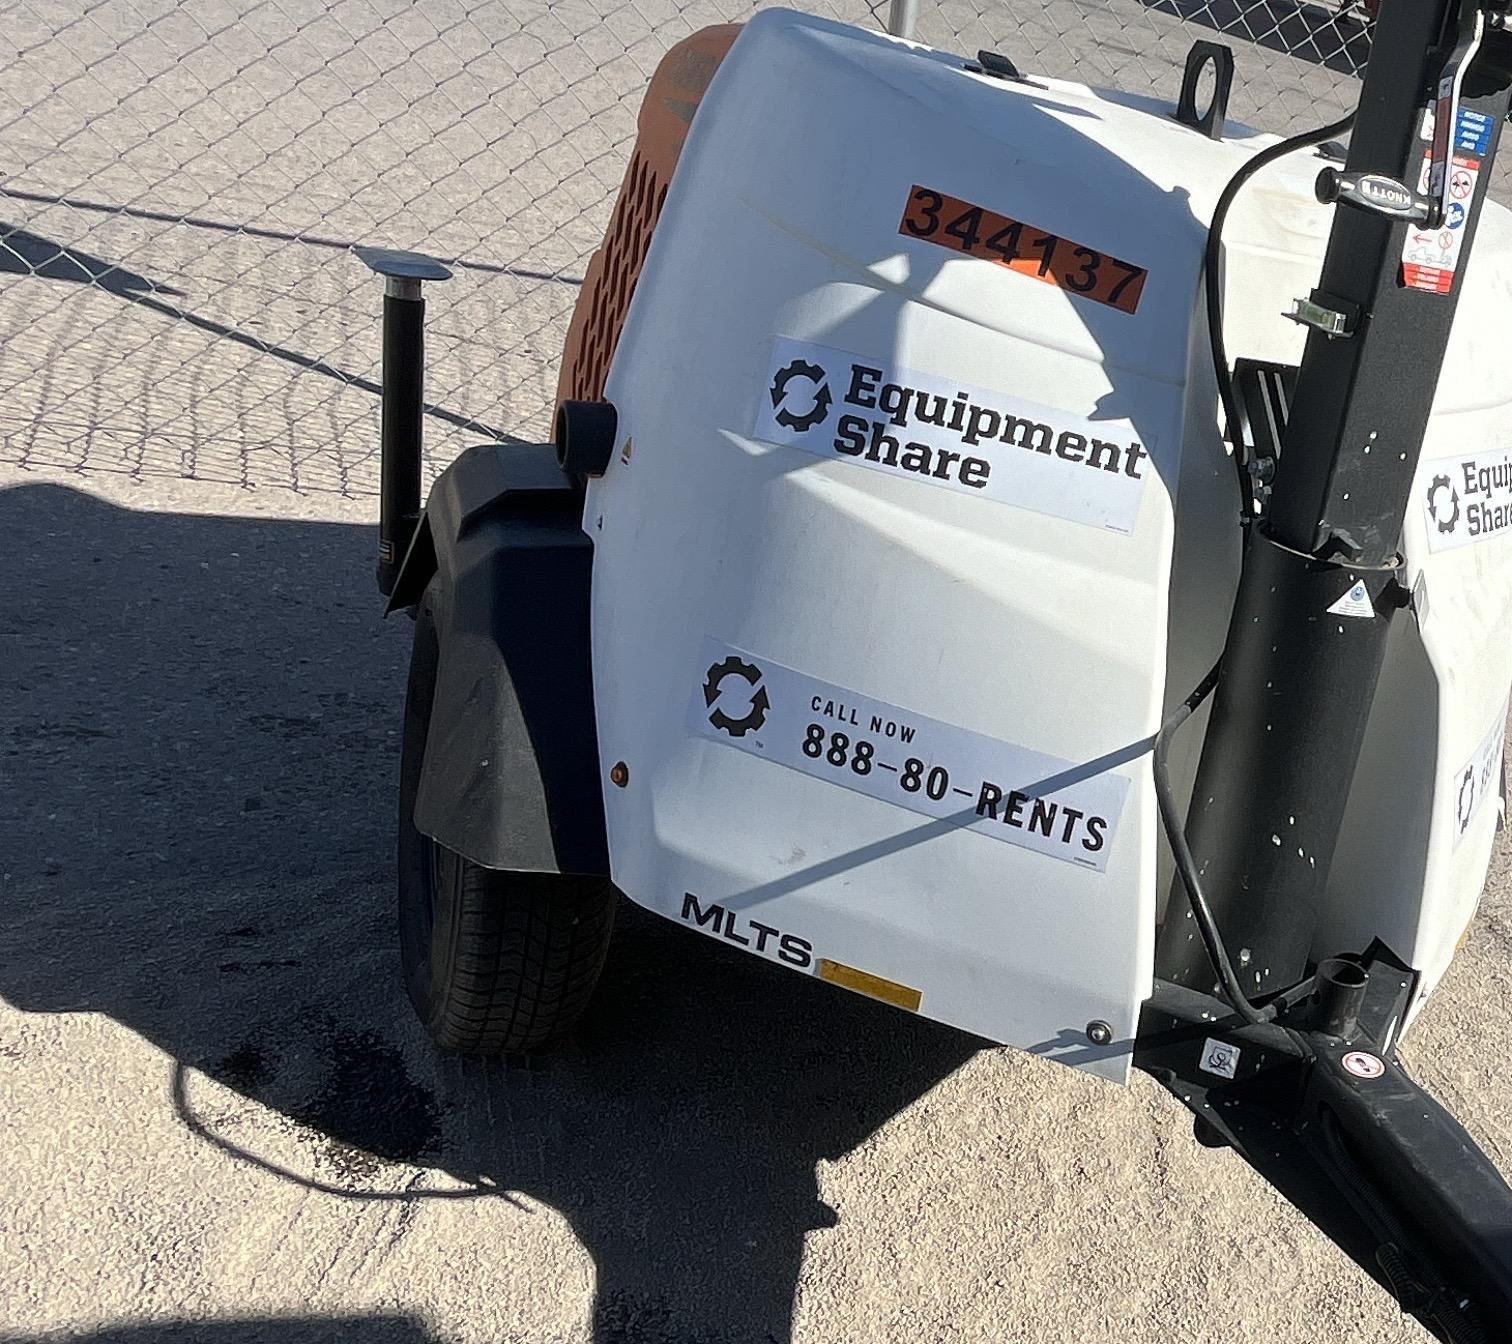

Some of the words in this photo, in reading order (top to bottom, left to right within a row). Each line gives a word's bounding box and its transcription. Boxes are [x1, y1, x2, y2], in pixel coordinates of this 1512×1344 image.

[904, 187, 1144, 306] 344137
[832, 414, 992, 490] Share
[843, 362, 1148, 482] Equipment
[810, 695, 860, 727] CALL
[869, 715, 917, 745] NOW
[801, 722, 1108, 853] 888-80-RENTS
[680, 891, 813, 968] MLTS
